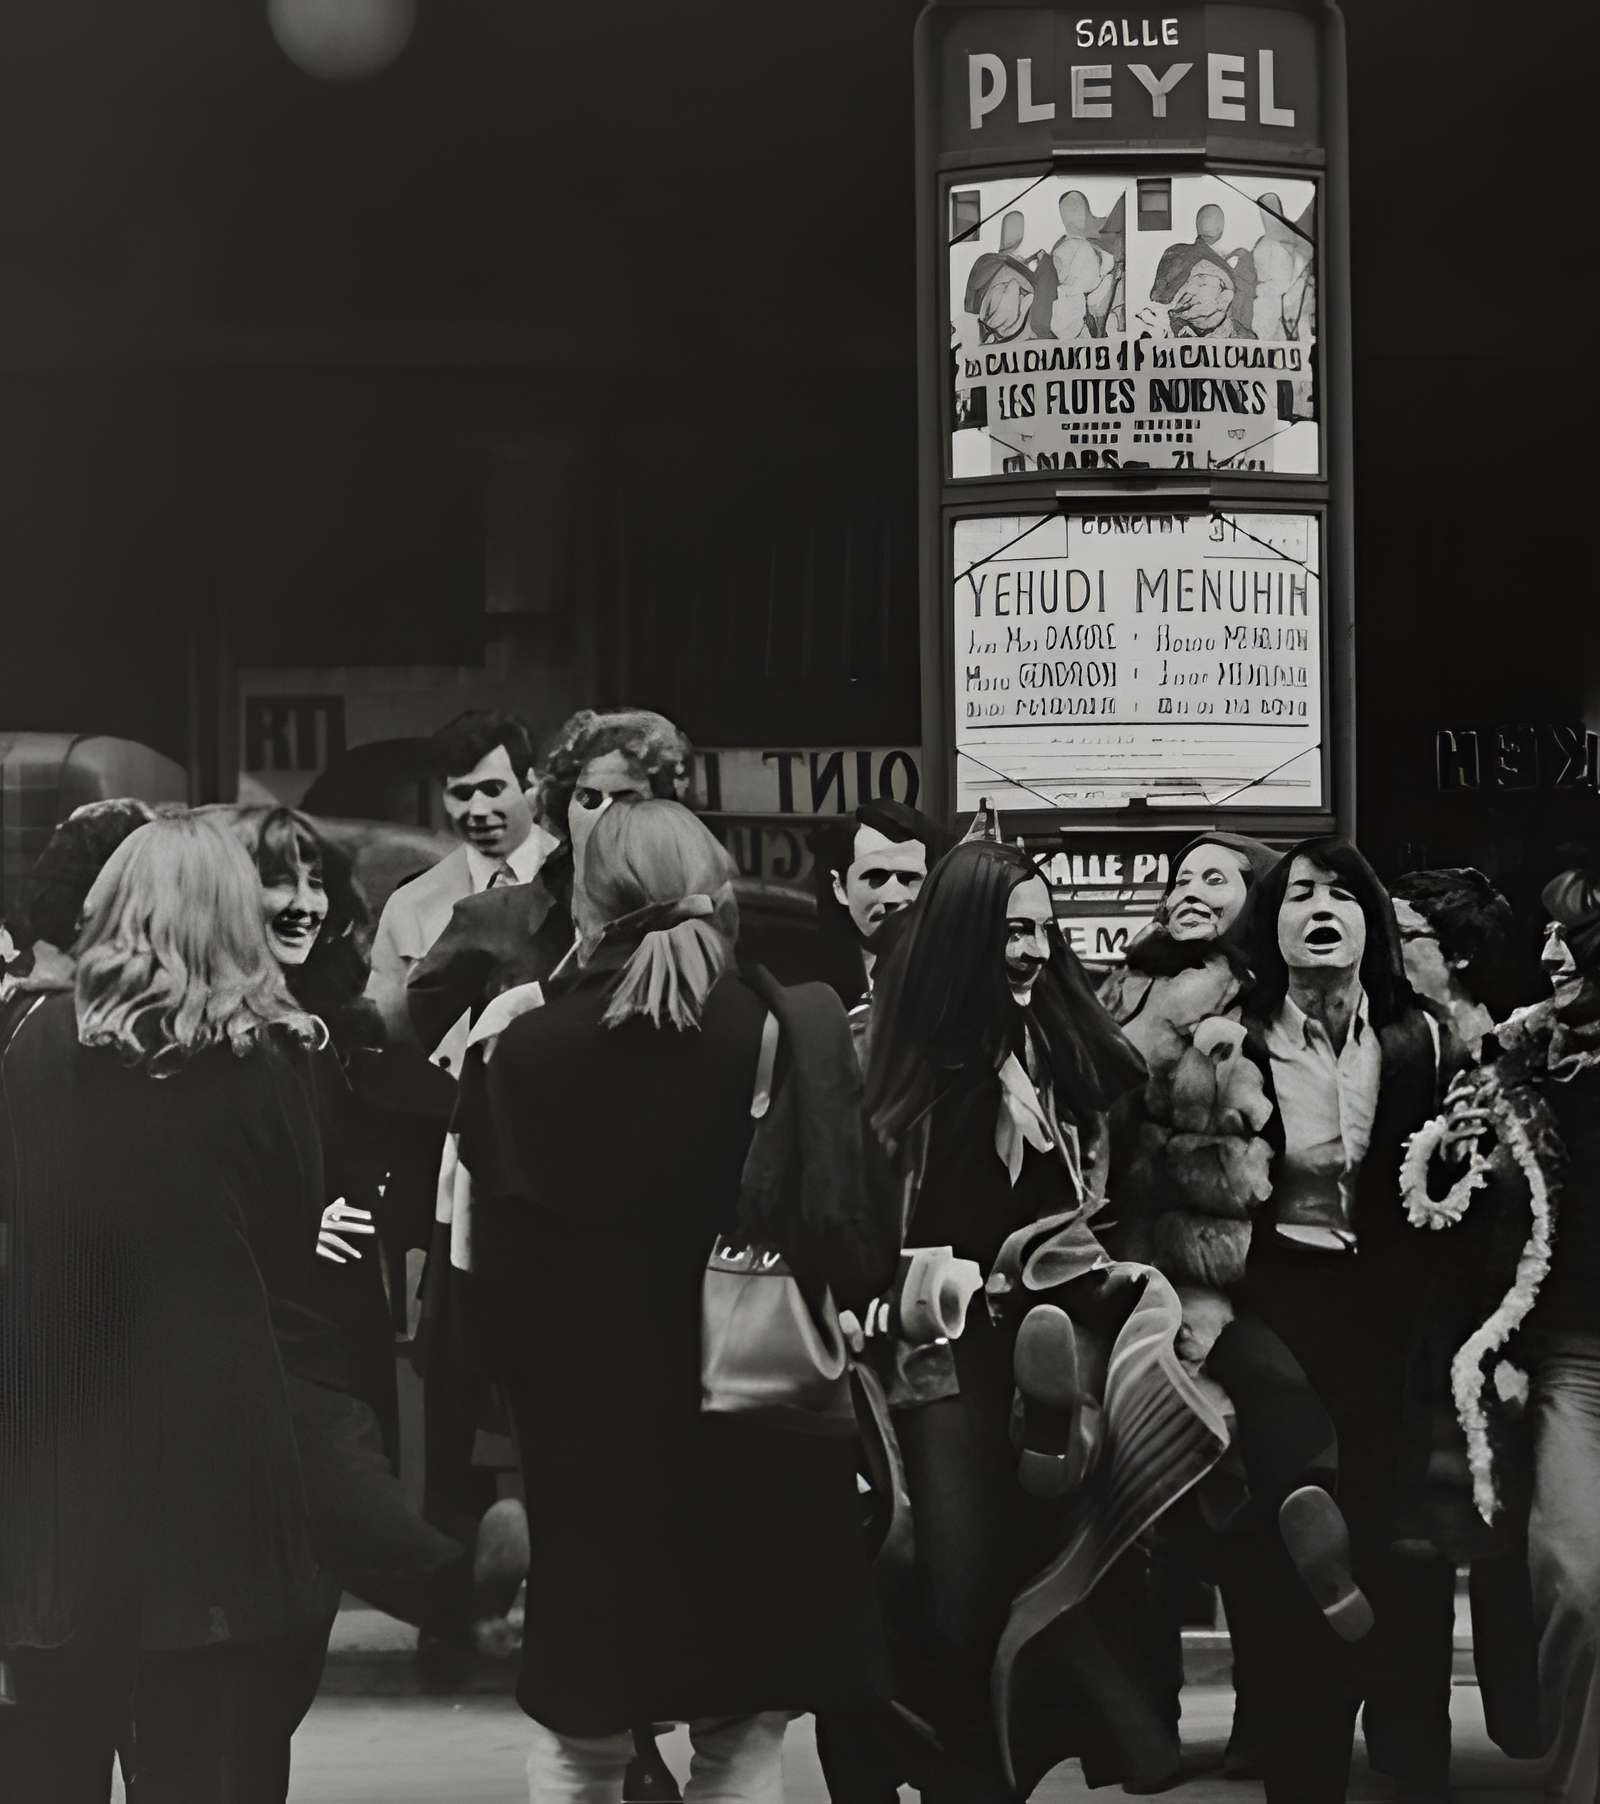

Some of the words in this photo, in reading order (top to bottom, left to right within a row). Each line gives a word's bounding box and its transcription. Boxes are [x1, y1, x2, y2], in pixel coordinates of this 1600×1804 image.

[1076, 18, 1180, 47] SALLE
[969, 50, 1296, 129] PLEYEL
[1046, 379, 1136, 415] FLUTES
[968, 569, 1106, 616] YEHUDI
